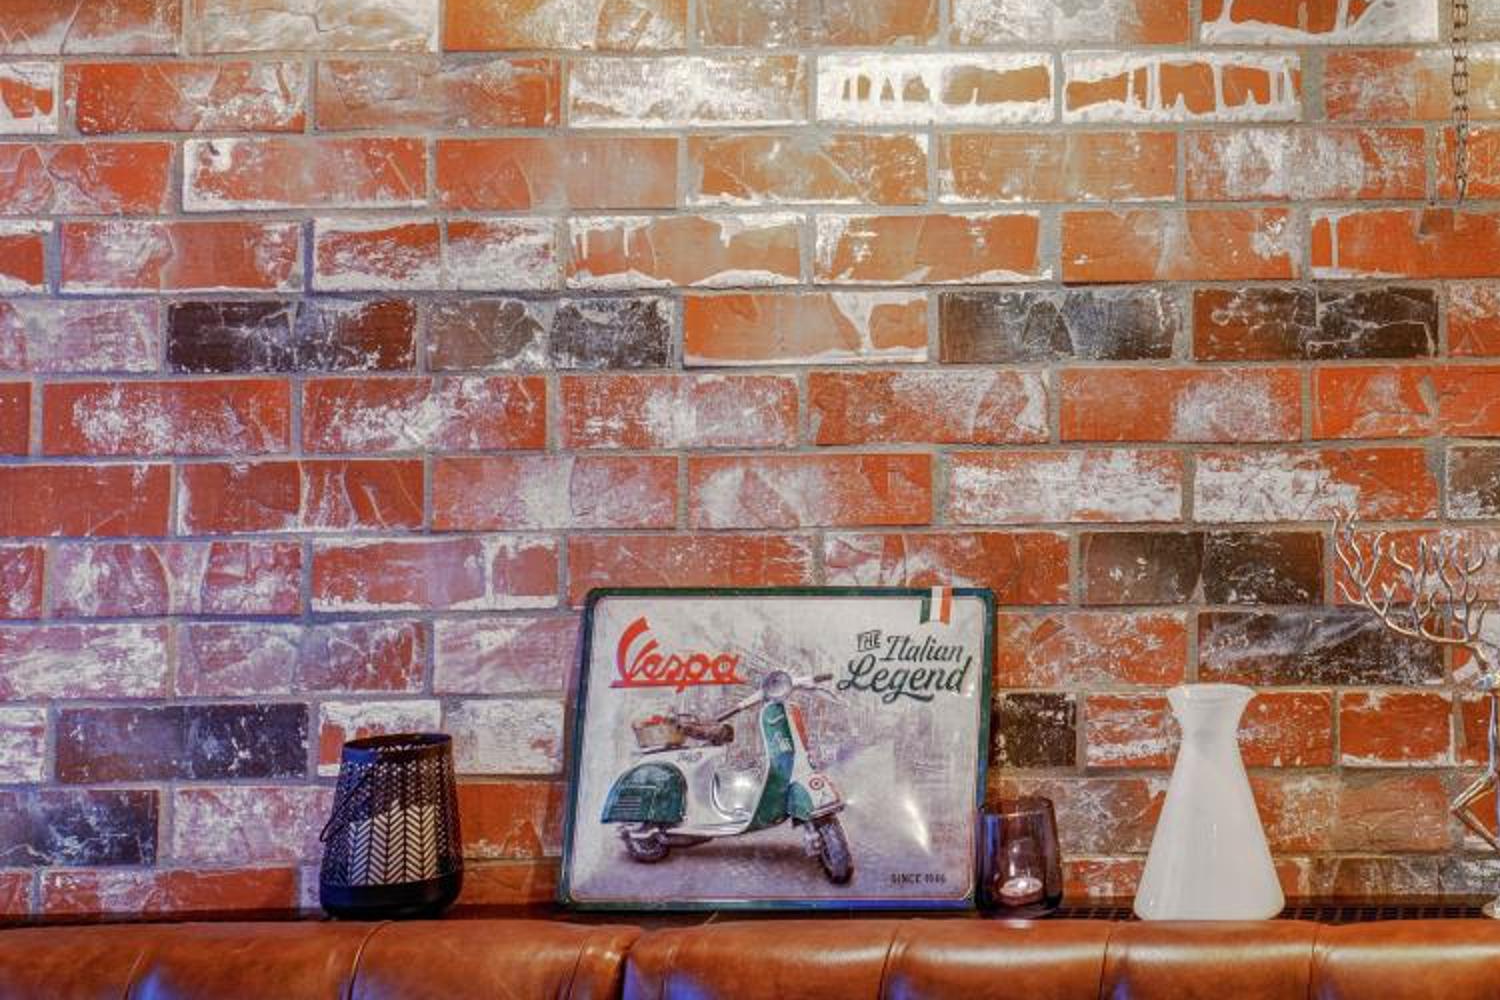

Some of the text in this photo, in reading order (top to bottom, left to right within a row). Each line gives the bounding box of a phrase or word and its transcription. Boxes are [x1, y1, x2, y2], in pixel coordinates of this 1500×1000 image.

[609, 616, 747, 694] Vespa
[857, 629, 965, 664] THE Italian
[837, 655, 974, 704] Legend
[890, 872, 922, 885] SINCE
